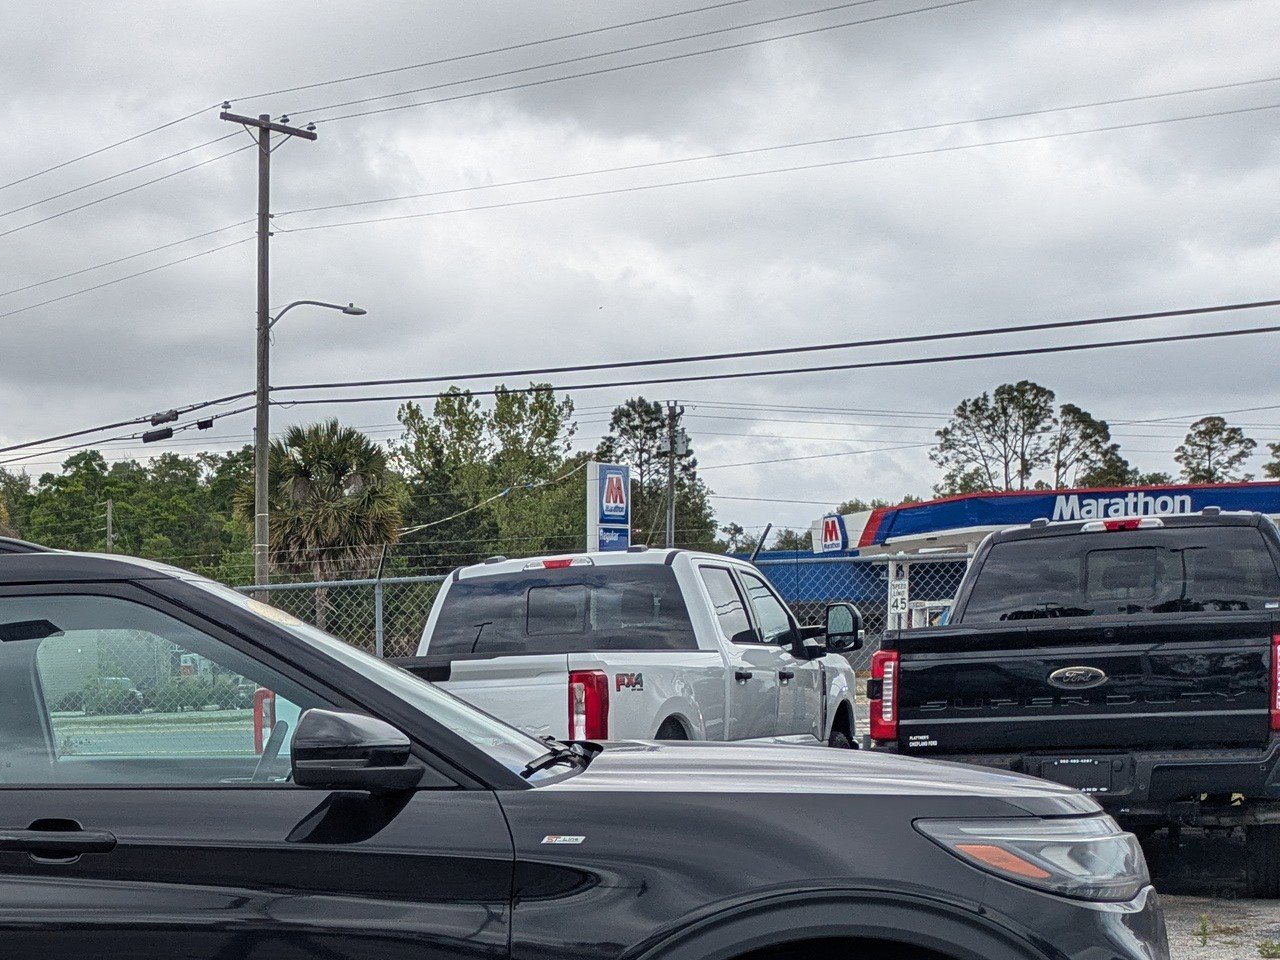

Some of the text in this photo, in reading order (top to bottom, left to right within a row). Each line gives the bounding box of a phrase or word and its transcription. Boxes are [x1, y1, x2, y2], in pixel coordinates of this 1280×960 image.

[1052, 492, 1192, 521] Marathon
[891, 598, 907, 610] 45
[615, 672, 644, 692] FX4
[1062, 670, 1092, 683] Ford
